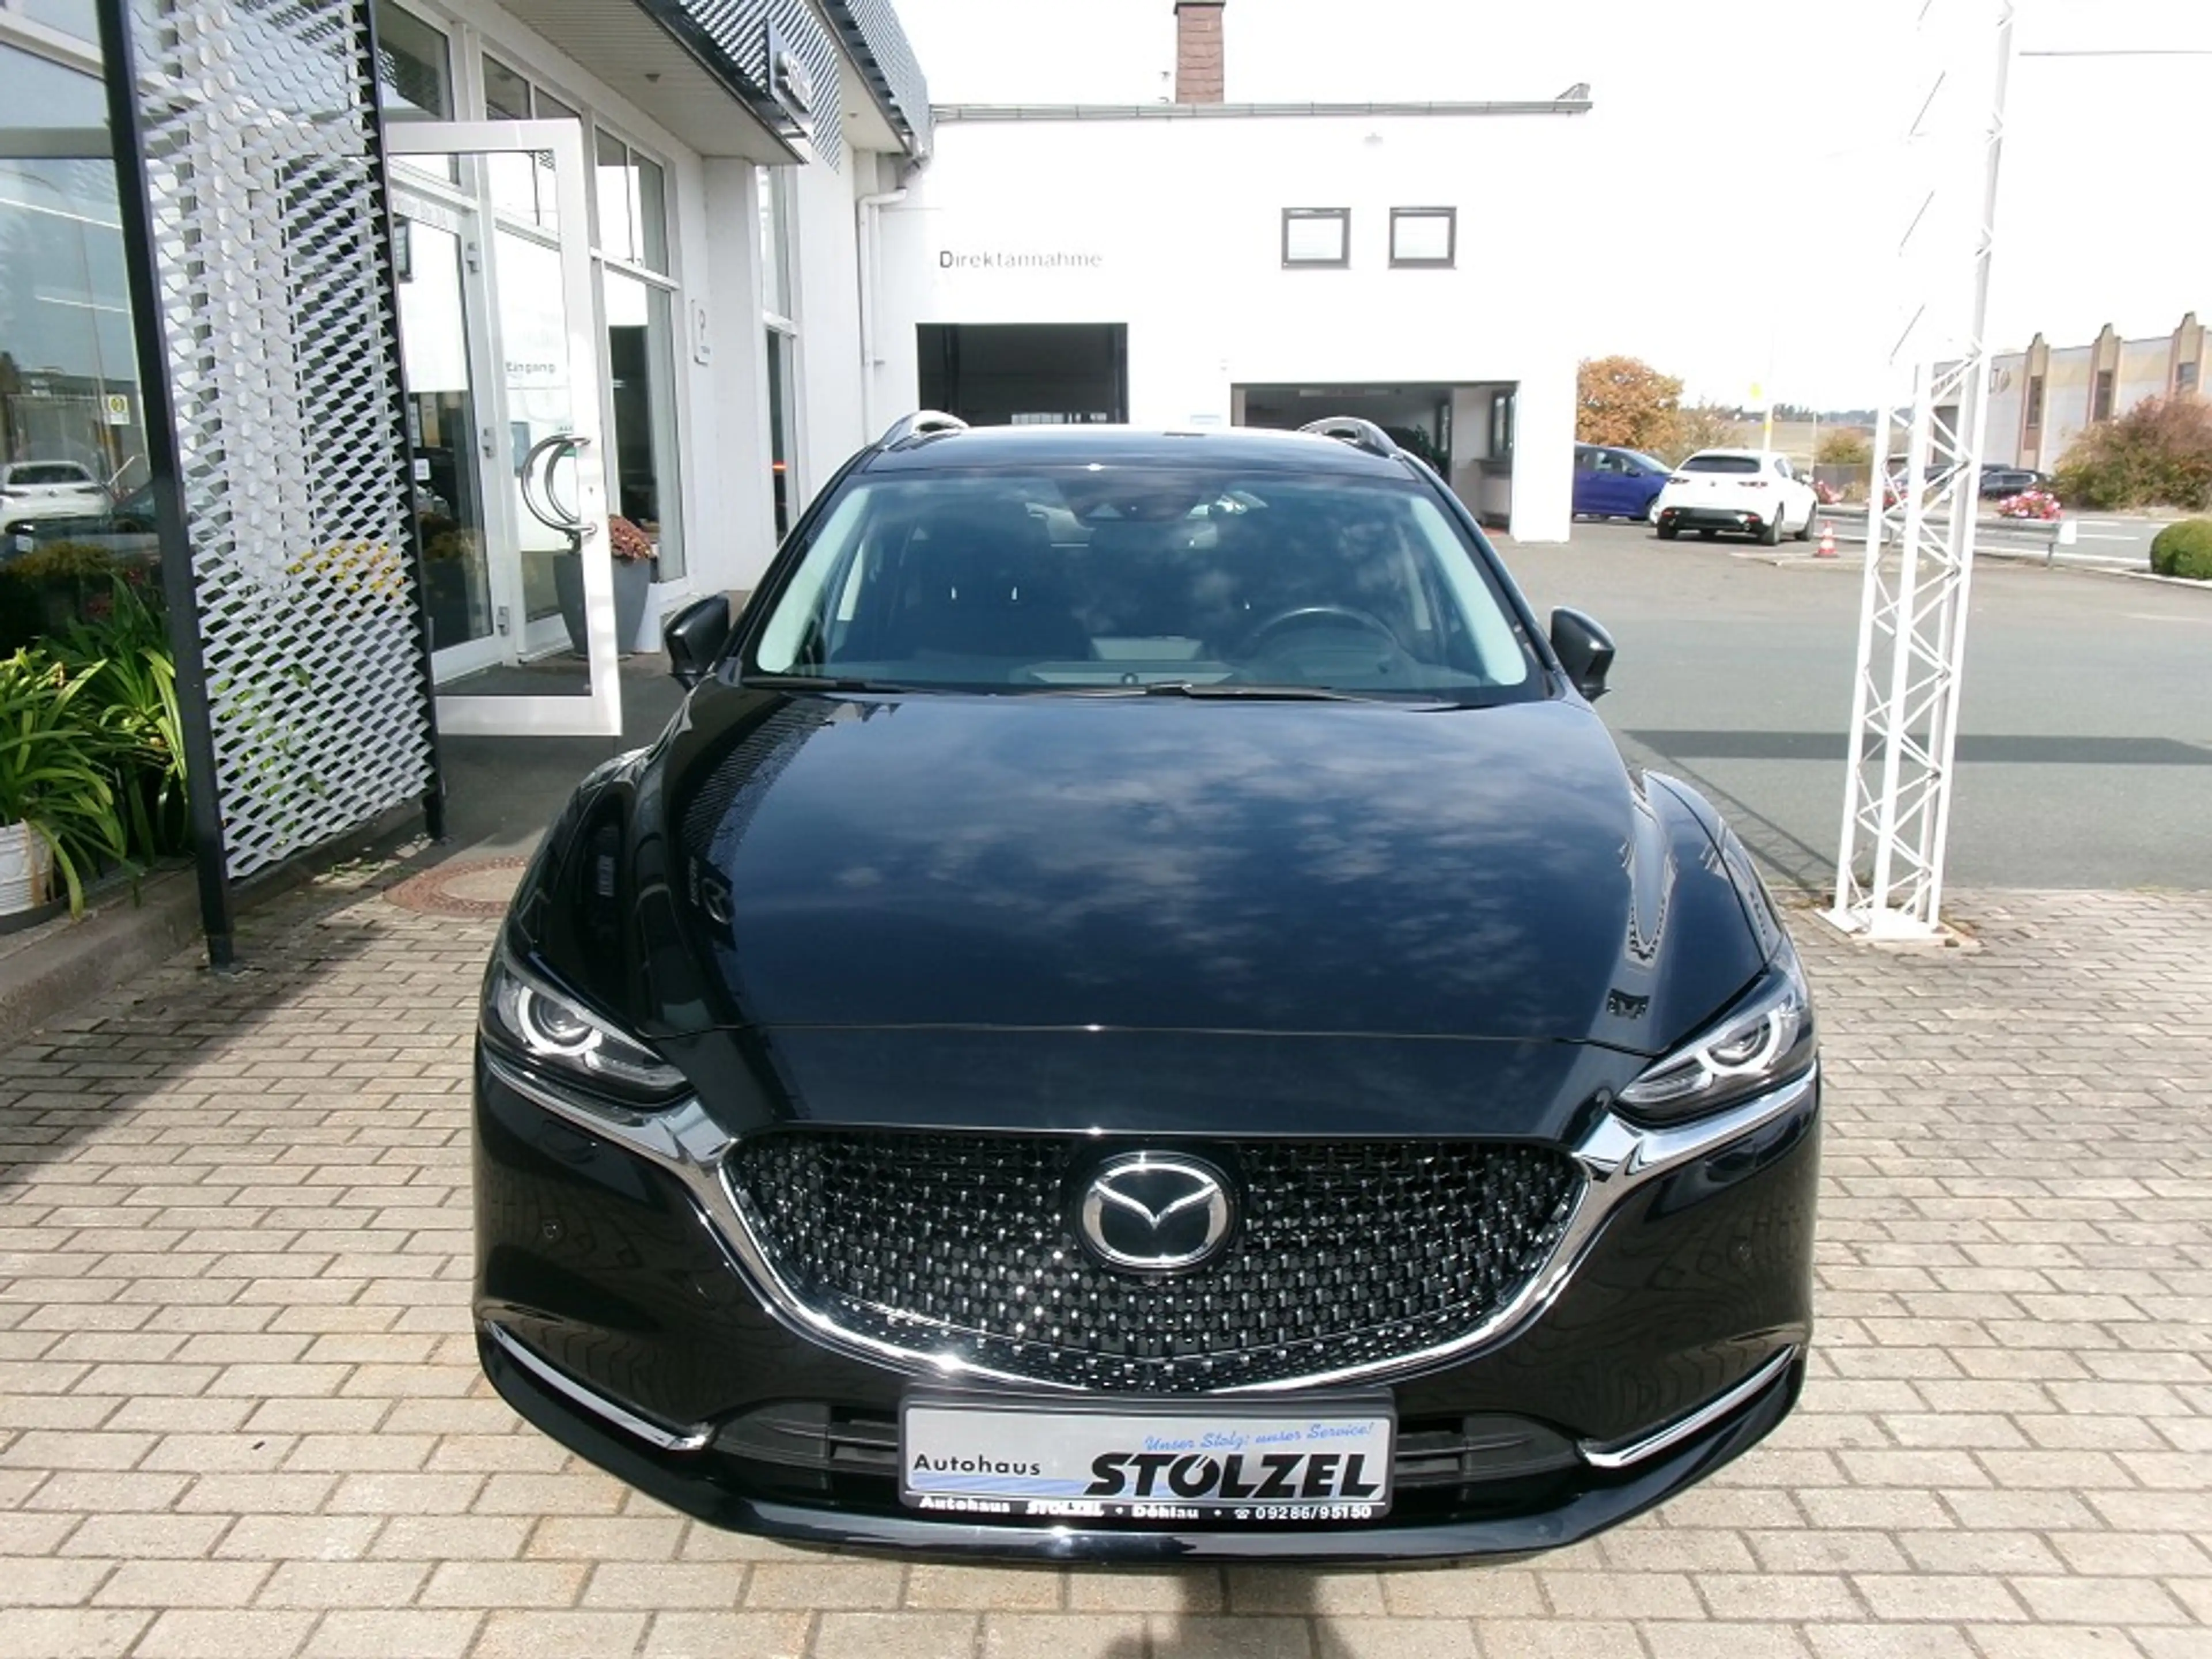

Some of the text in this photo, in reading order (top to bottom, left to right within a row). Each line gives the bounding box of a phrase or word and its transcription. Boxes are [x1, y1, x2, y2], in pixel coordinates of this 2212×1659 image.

[940, 251, 1103, 268] Direktannahme
[1145, 1435, 1194, 1450] Unser
[1256, 1431, 1301, 1444] unser
[1308, 1422, 1374, 1439] Service!
[914, 1454, 1040, 1475] Autohaus
[920, 1497, 1010, 1513] Autohaus
